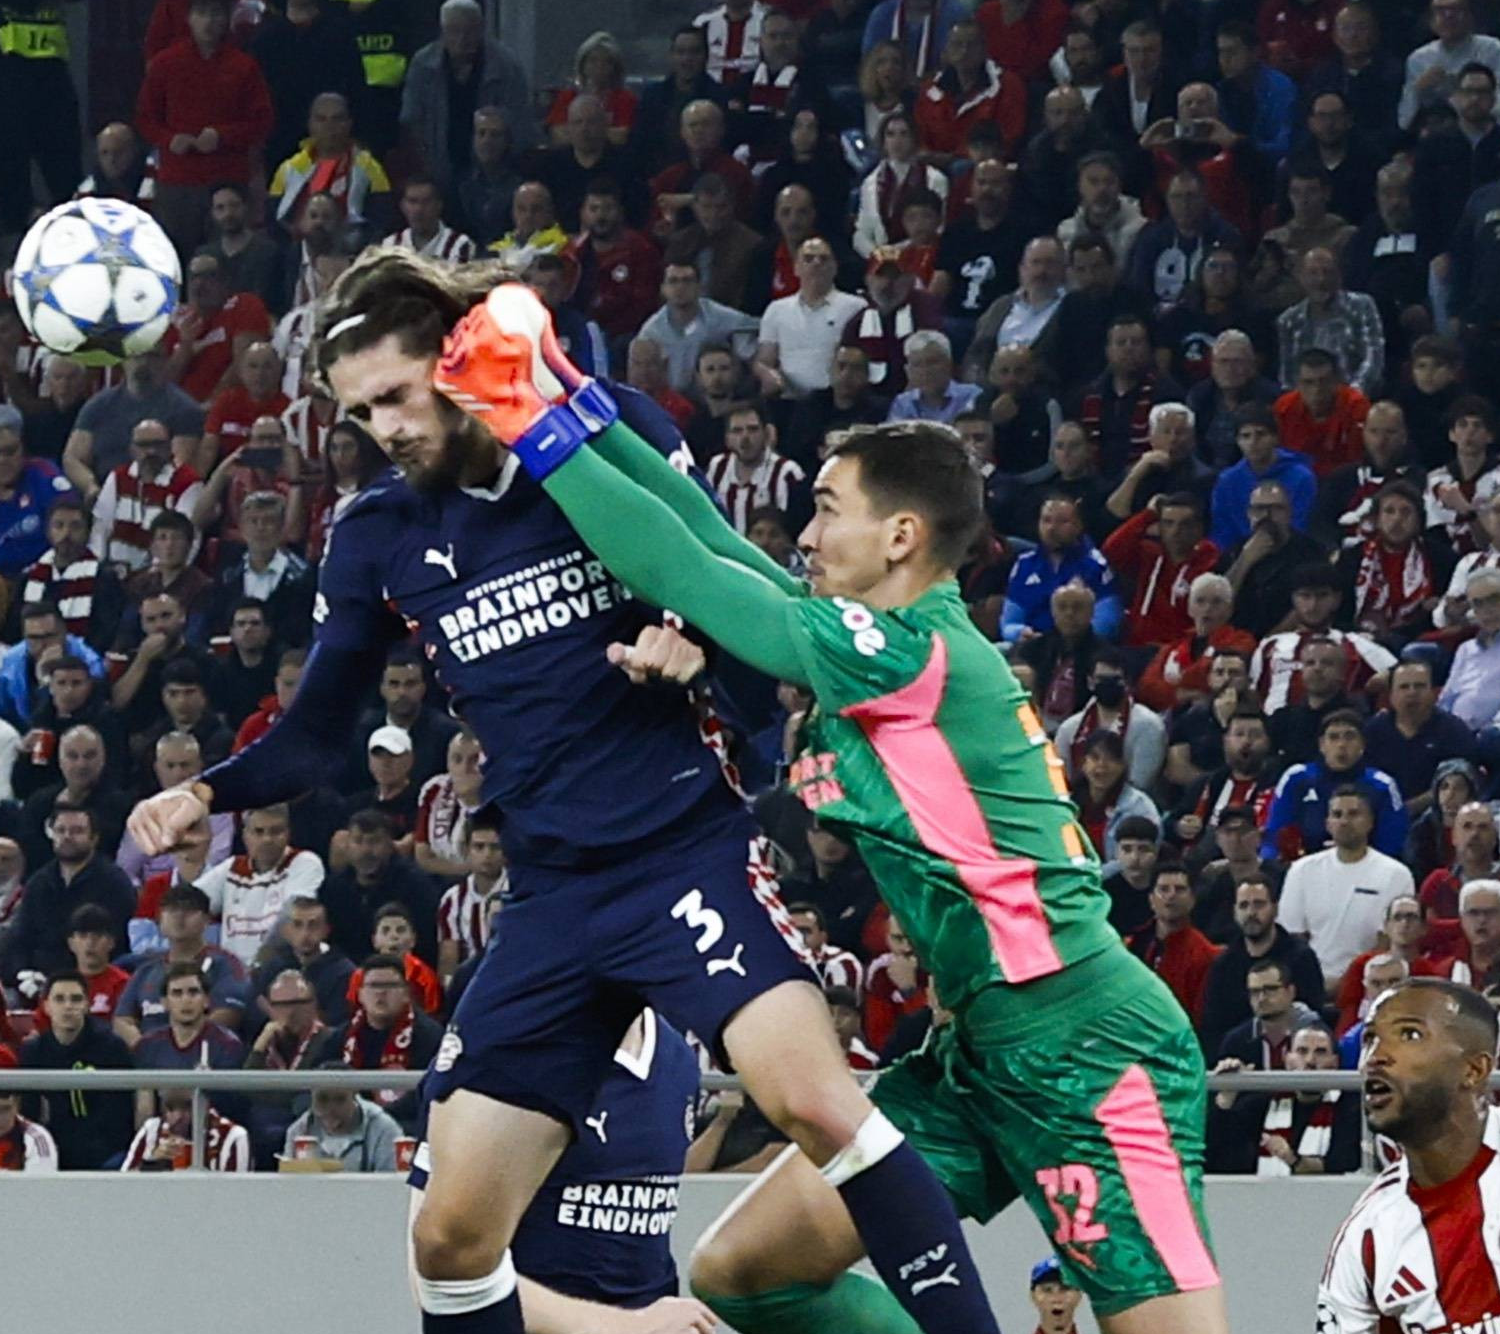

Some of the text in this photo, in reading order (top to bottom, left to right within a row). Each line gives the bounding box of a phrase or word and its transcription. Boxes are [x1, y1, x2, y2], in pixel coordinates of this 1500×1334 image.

[438, 560, 608, 641] BRAINPOR
[670, 888, 724, 954] 3
[899, 1242, 948, 1280] PSV
